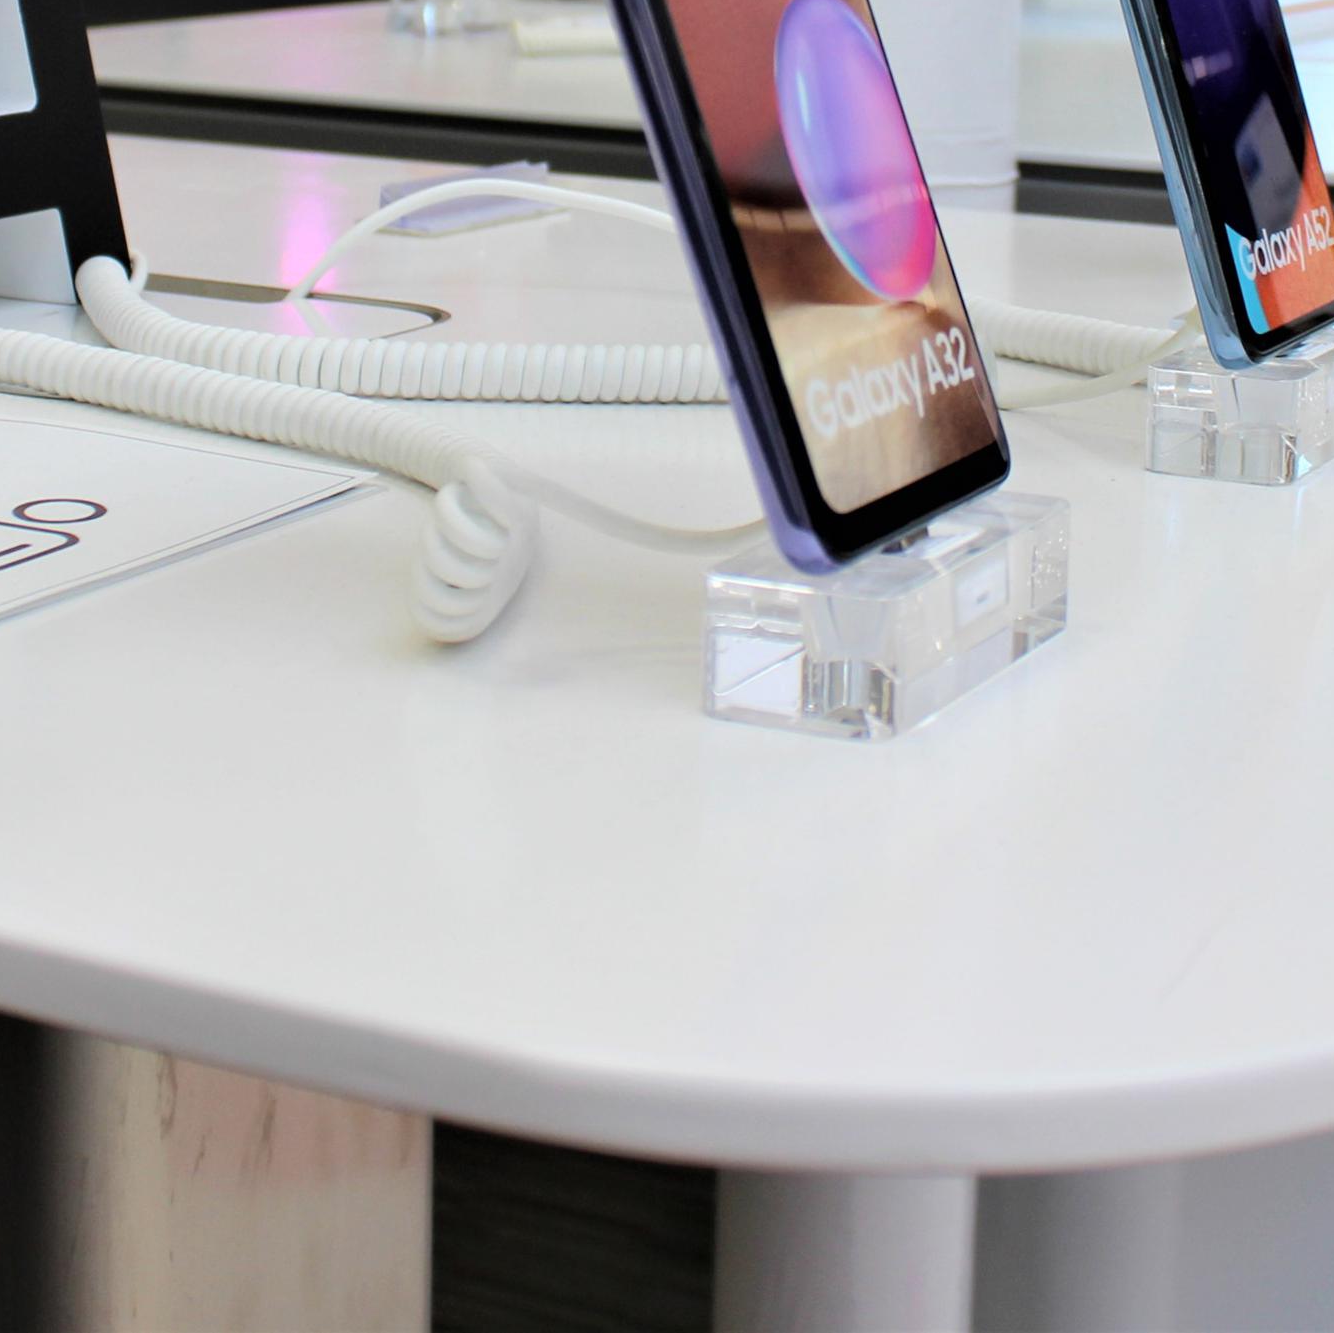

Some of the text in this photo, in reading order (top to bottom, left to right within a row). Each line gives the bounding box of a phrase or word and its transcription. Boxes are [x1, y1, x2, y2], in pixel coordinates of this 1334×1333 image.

[1238, 224, 1306, 282] Galaxy
[806, 326, 975, 440] Galaxy A32
